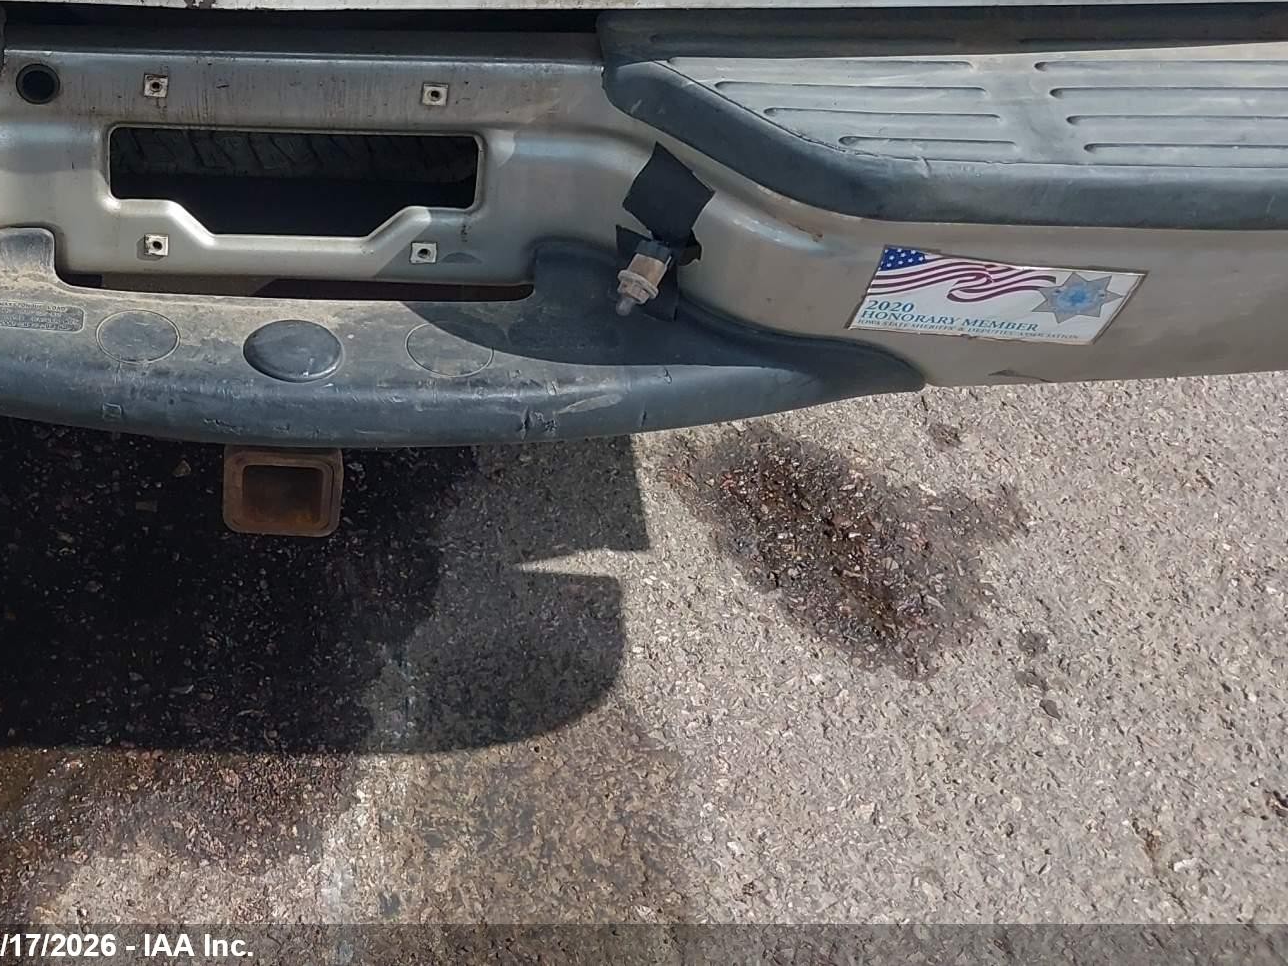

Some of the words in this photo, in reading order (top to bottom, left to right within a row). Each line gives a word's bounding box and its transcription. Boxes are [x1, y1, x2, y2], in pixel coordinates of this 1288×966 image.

[865, 300, 914, 313] 2020
[861, 310, 961, 325] HONORARY
[962, 318, 1039, 332] MEMBER
